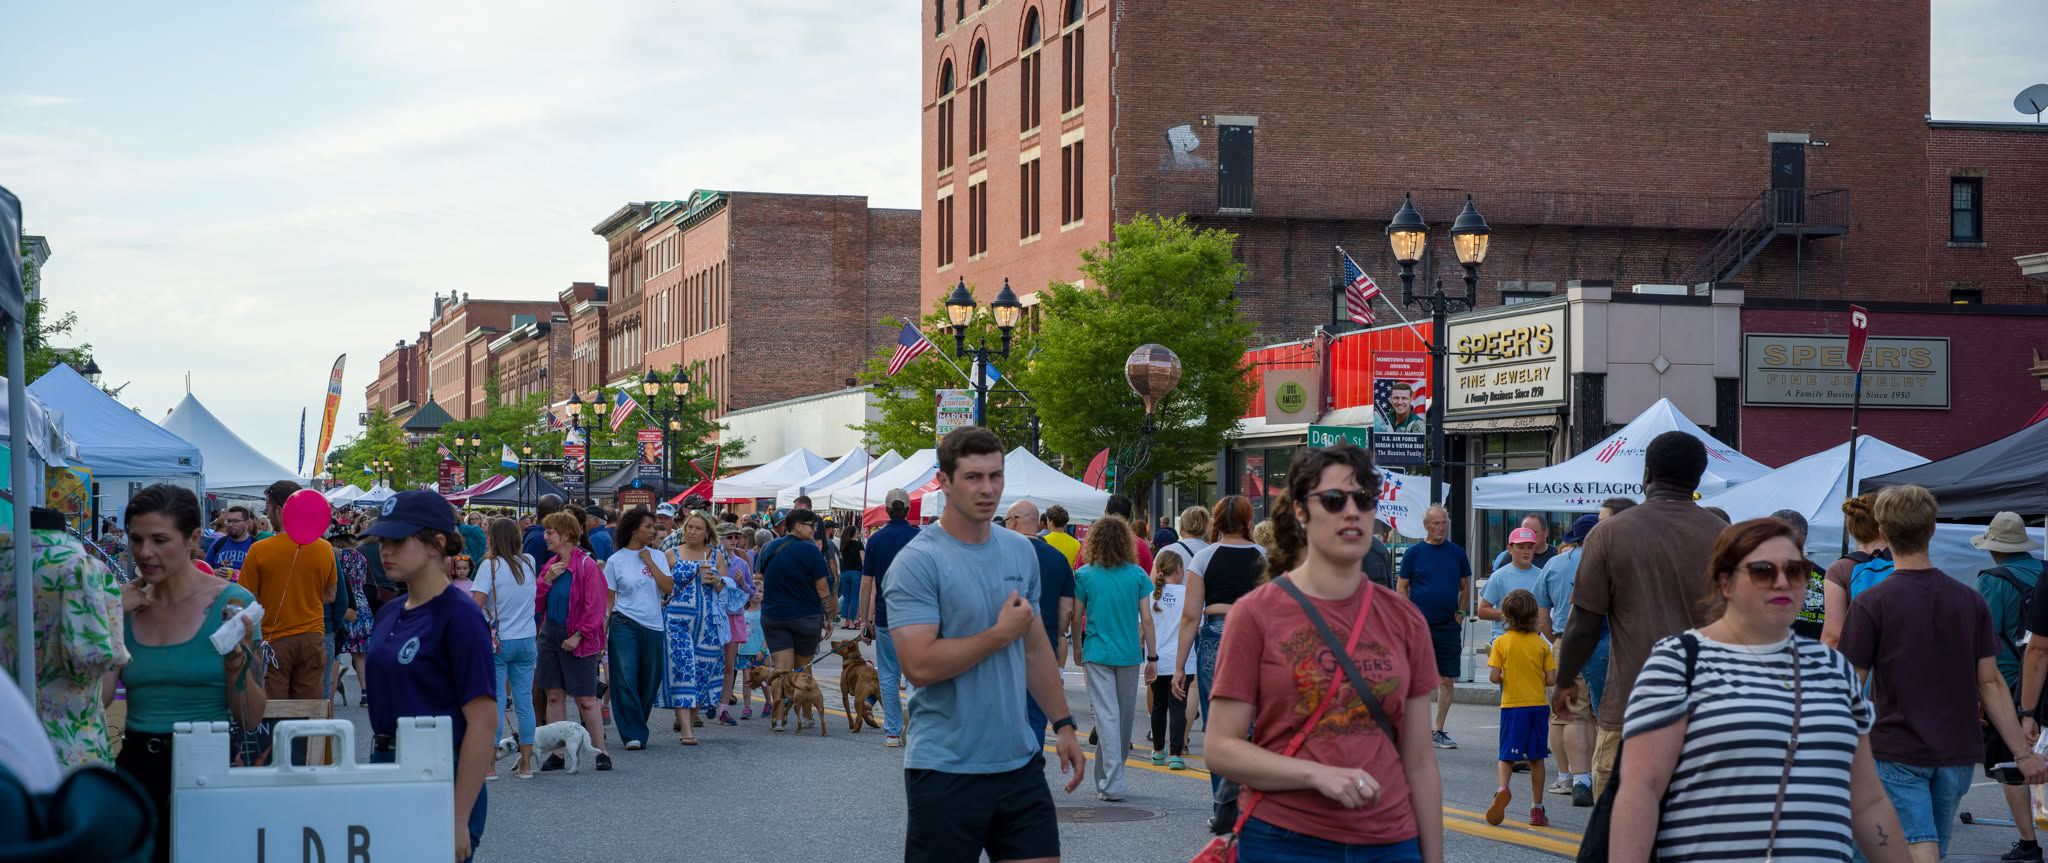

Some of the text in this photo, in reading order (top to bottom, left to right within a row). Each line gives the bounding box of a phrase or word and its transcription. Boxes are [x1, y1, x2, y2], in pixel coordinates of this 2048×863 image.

[1458, 324, 1552, 363] SPEER'S
[1460, 367, 1550, 389] FINE JEWELRY
[1766, 374, 1928, 387] FINE JEWELRY
[1287, 385, 1296, 394] DOS
[1282, 394, 1301, 404] AMIGOS
[1465, 386, 1544, 404] A Family Business Since 1950
[1795, 390, 1821, 400] Family
[1826, 391, 1859, 399] Busine
[1866, 391, 1887, 399] Since
[1892, 391, 1911, 400] 1950
[1352, 436, 1362, 446] St
[1407, 450, 1421, 458] Family
[1528, 482, 1643, 495] FLAGS & FLAGPO
[1379, 504, 1408, 512] WORKS
